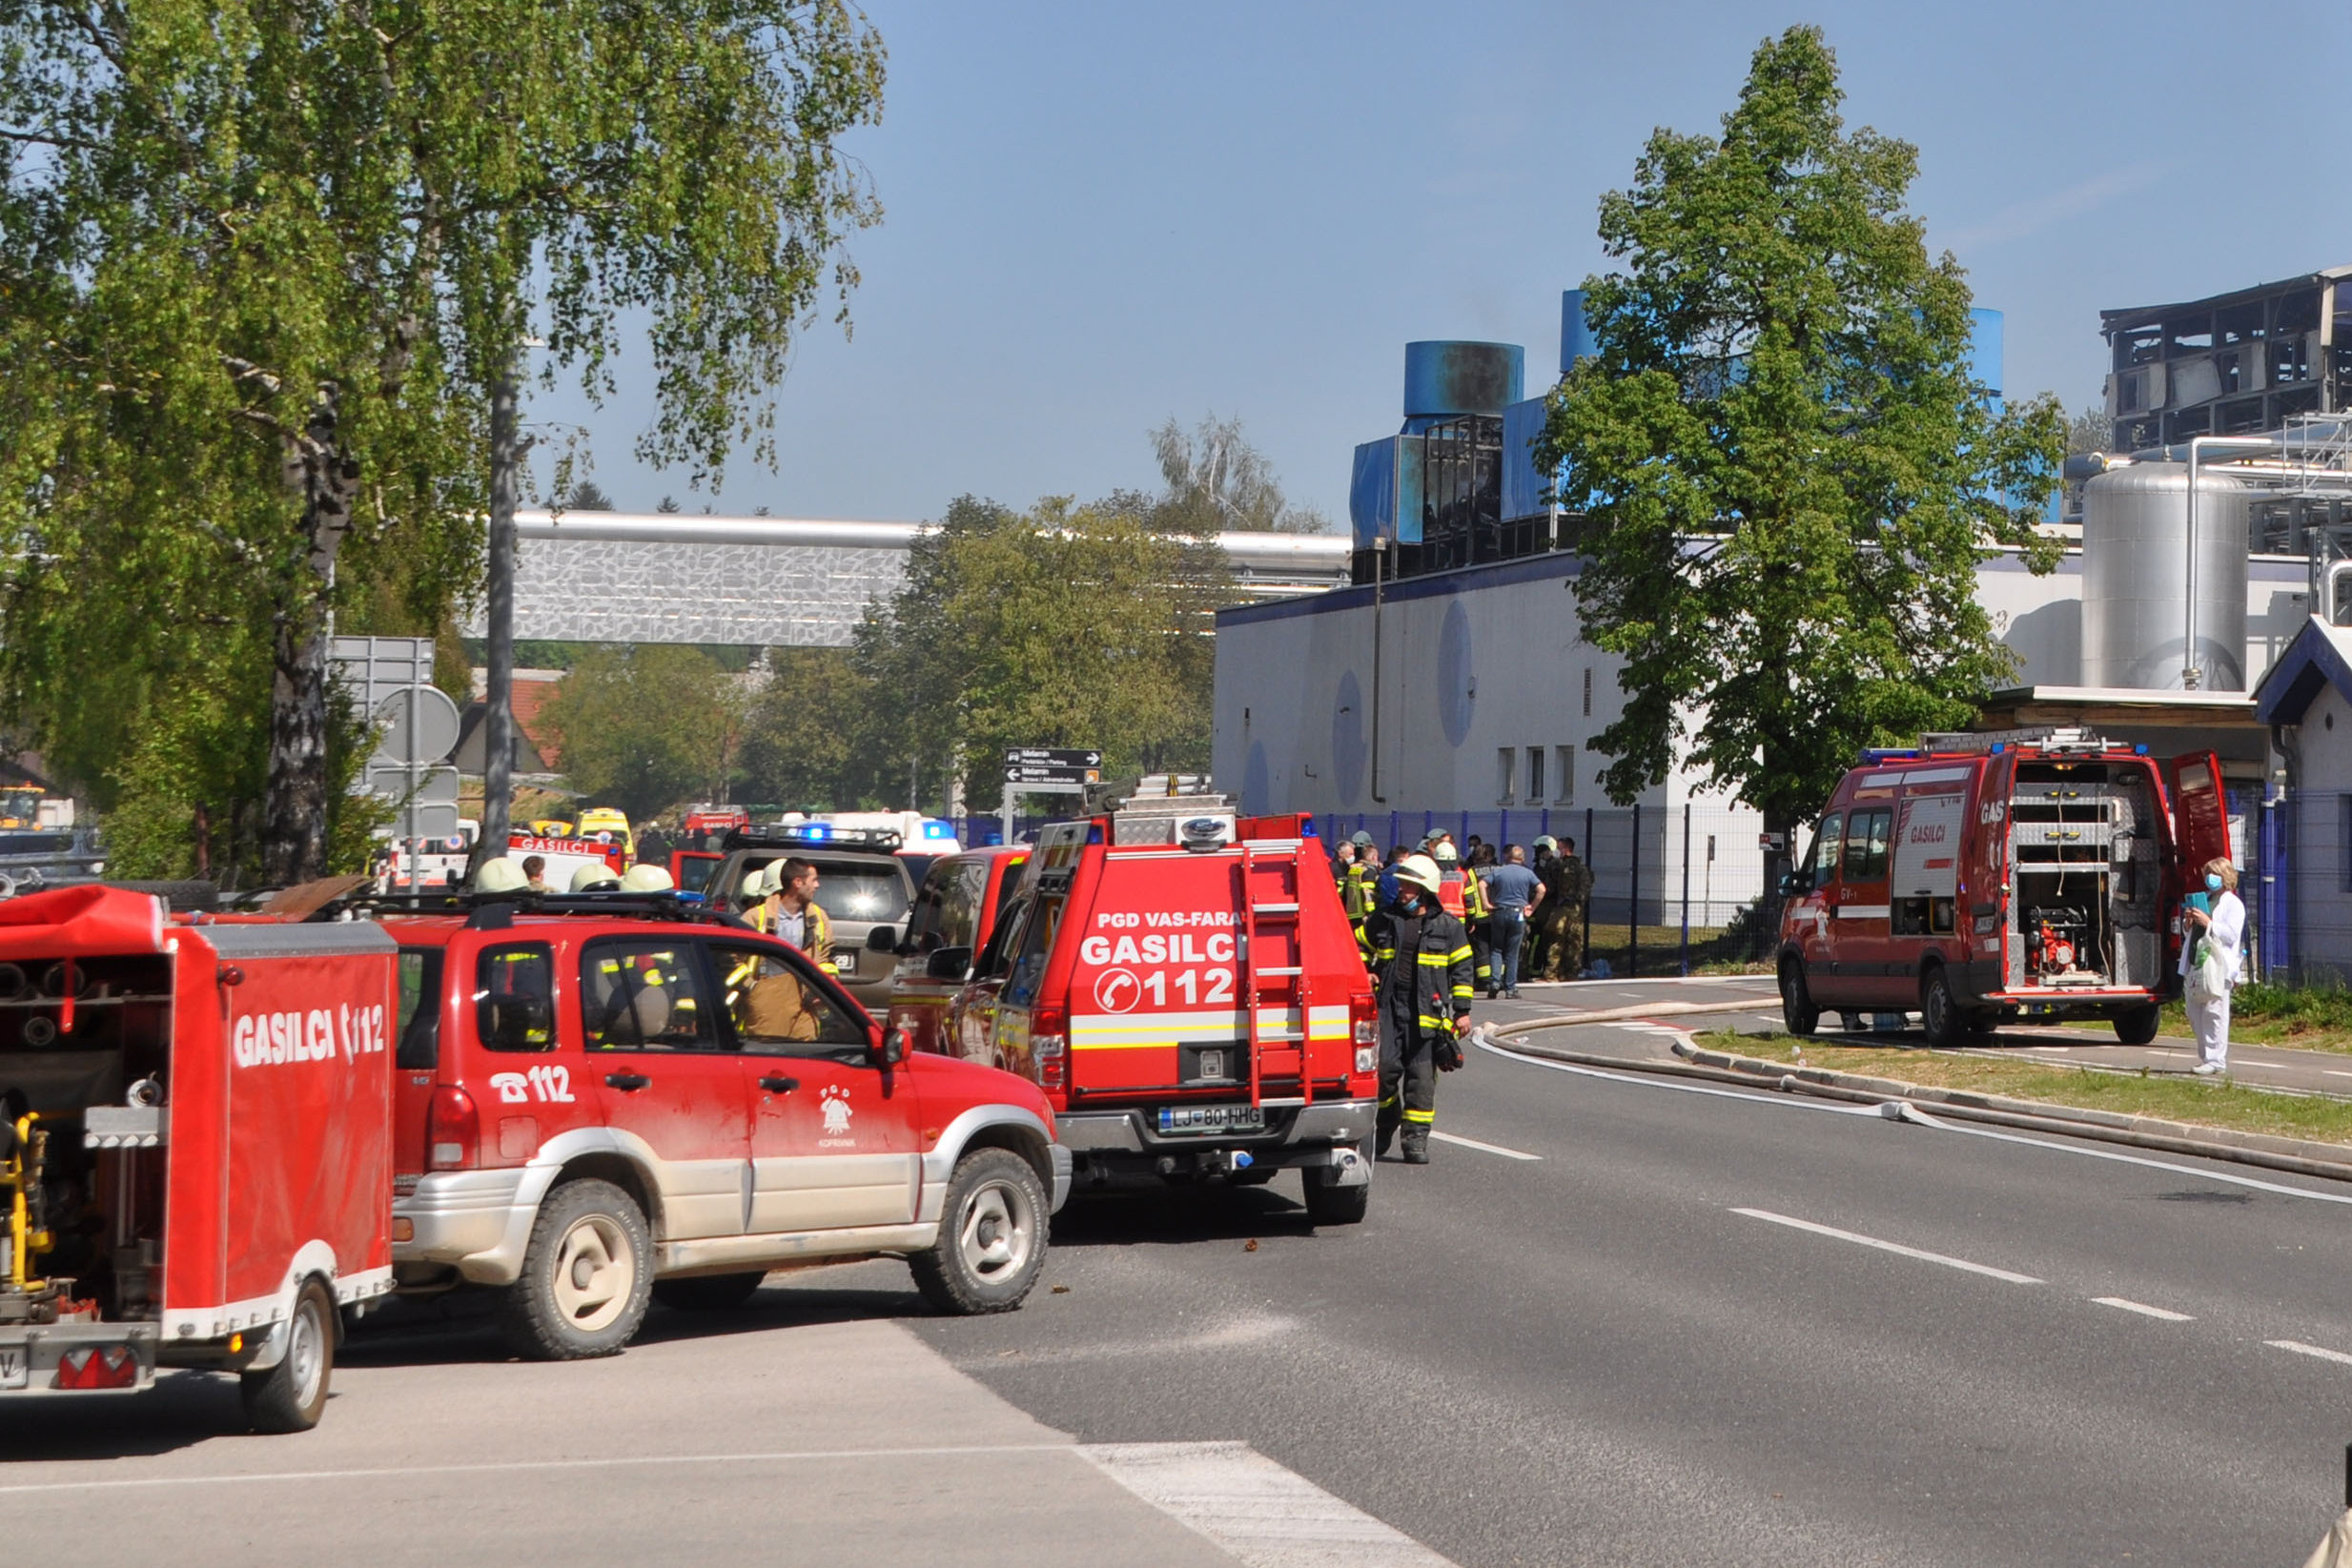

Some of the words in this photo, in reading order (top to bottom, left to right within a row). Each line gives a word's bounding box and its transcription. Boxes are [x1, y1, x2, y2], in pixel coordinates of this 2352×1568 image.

[1911, 825, 1945, 845] GASILCI
[522, 839, 588, 854] GASILCI
[1098, 912, 1140, 927] PGD
[1145, 912, 1242, 927] VAS-FARA
[1143, 967, 1235, 1007] 112
[235, 1009, 336, 1068] GASILCI
[352, 1005, 383, 1053] 112
[527, 1065, 576, 1103] 112
[1174, 1110, 1192, 1127] LJ
